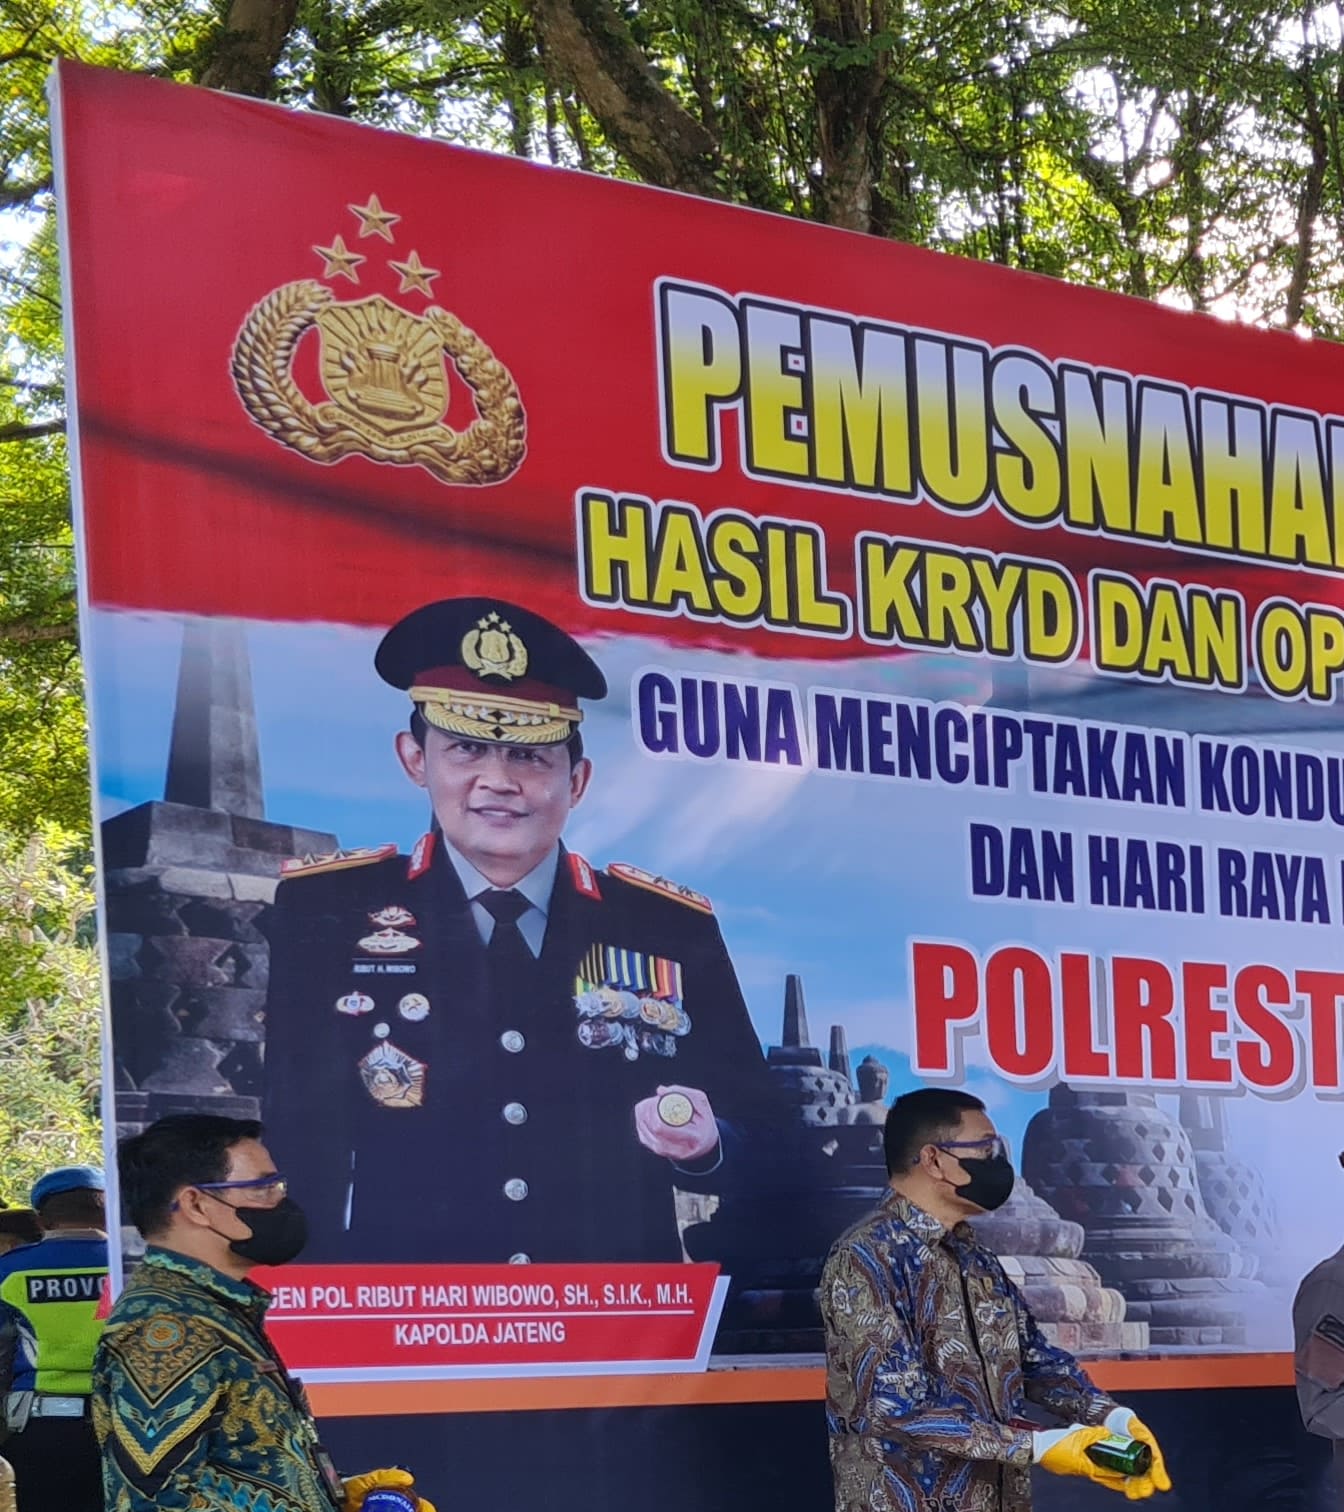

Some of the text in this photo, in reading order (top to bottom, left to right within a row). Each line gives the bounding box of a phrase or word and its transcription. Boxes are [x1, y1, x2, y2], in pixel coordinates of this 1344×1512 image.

[579, 490, 850, 637] HASIL
[857, 536, 1078, 666] KRYD
[1090, 572, 1245, 691] DAN
[638, 673, 801, 765] GUNA
[811, 694, 1187, 808] MENCIPTAKAN
[969, 823, 1074, 903] DAN
[1088, 834, 1205, 914] HARI
[1218, 847, 1330, 925] RAYA
[29, 1276, 108, 1299] PROV
[311, 1286, 353, 1308] POL
[357, 1285, 416, 1308] RIBUT
[421, 1284, 468, 1307] HARI
[472, 1283, 559, 1308] WIBOWO,
[603, 1284, 653, 1307] S.I.K.,
[657, 1283, 694, 1304] M.H.
[394, 1321, 566, 1346] KAPOLDA JATENG
